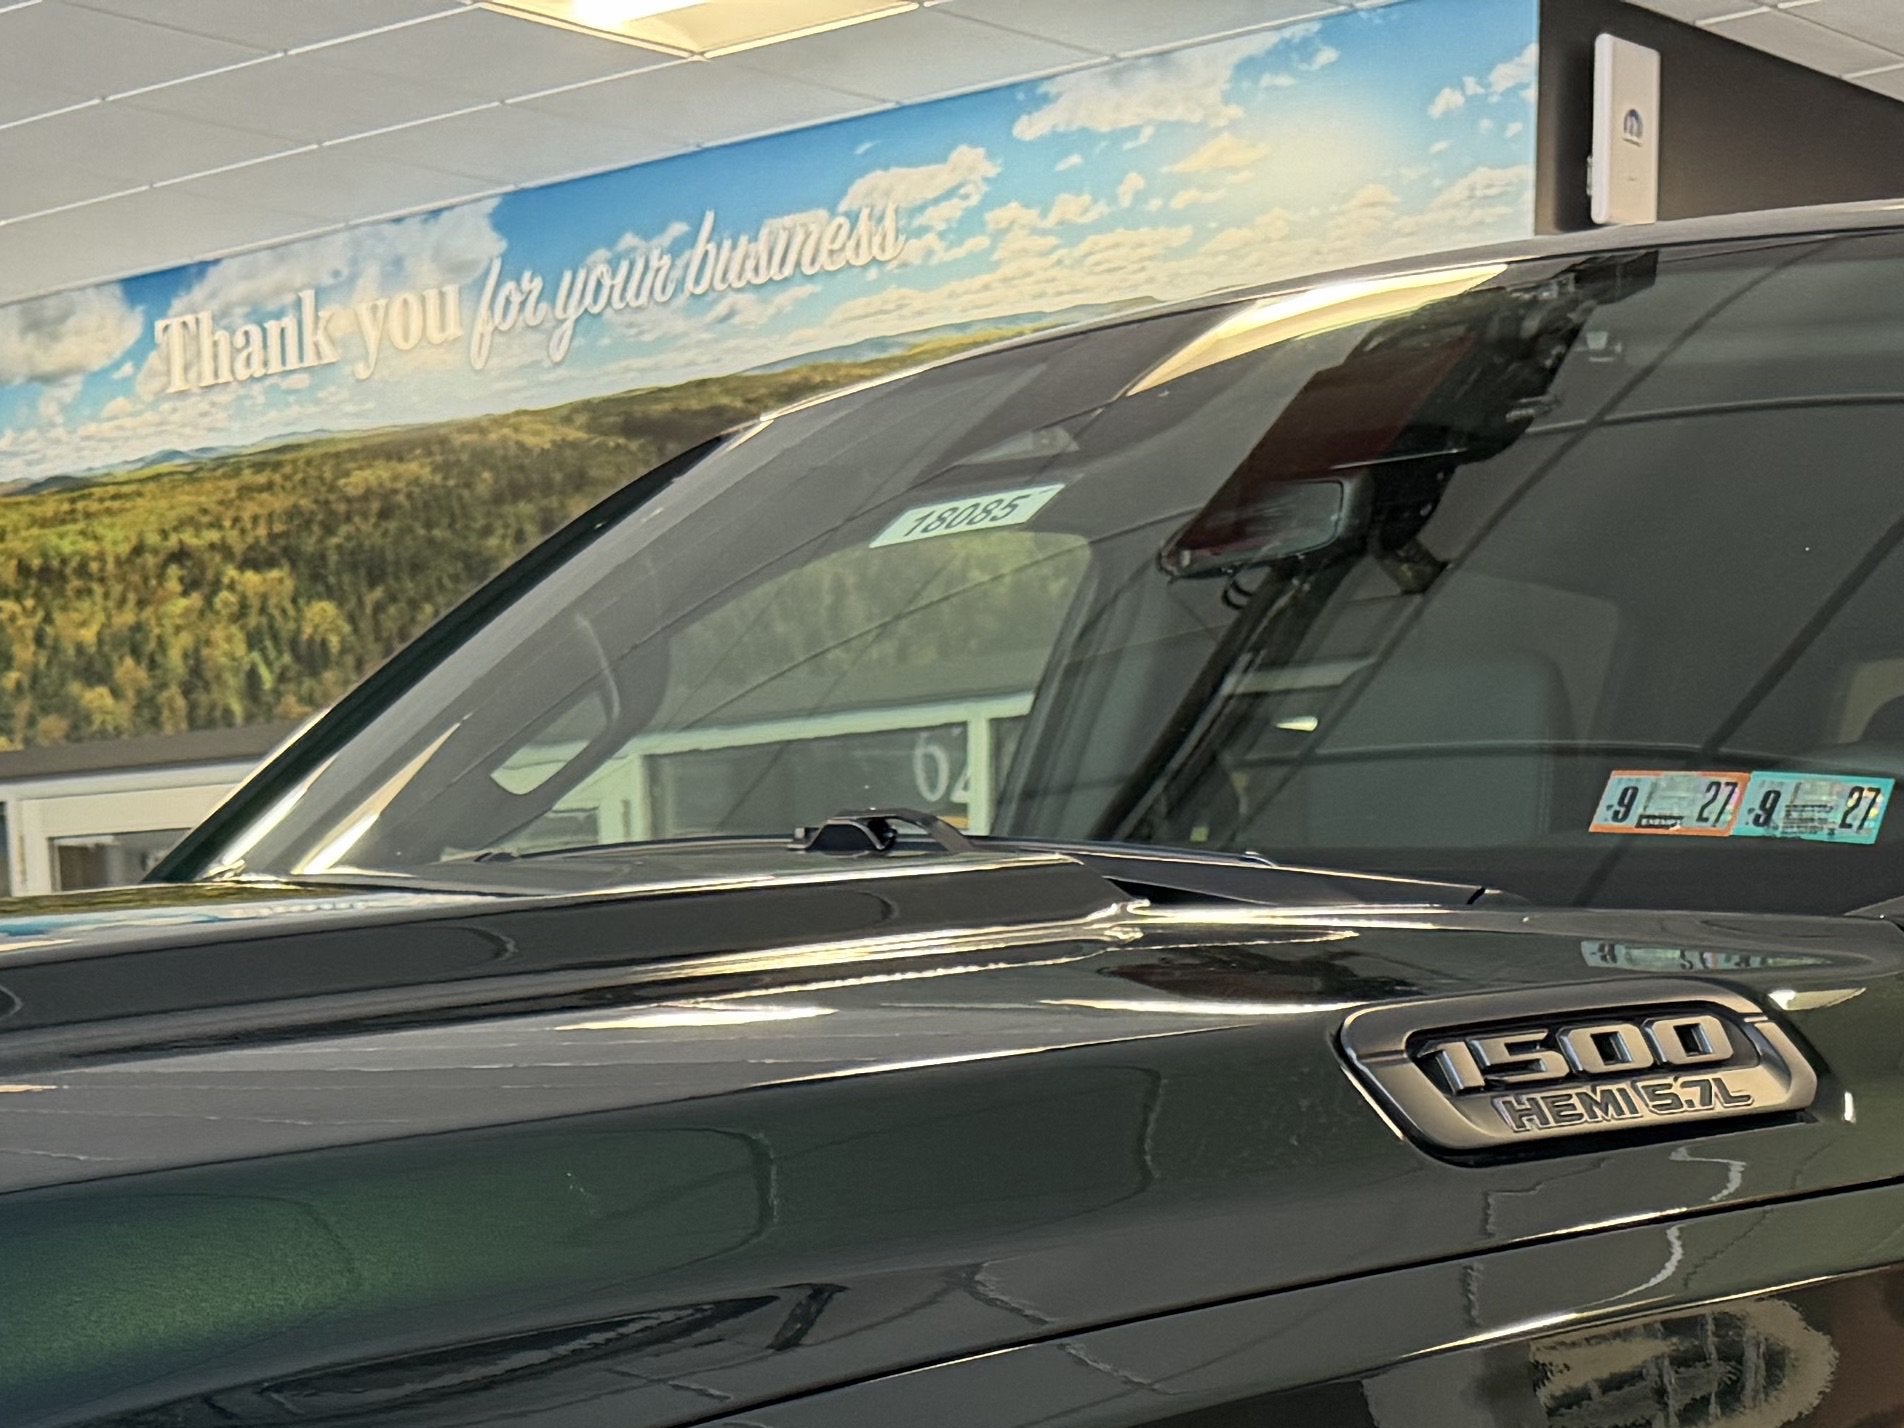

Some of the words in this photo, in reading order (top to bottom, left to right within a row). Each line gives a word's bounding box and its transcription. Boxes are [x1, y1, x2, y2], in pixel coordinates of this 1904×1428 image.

[155, 289, 341, 396] Thank
[353, 283, 466, 382] you
[468, 256, 550, 372] for
[552, 246, 676, 364] your
[684, 204, 908, 297] business
[904, 494, 1031, 538] 18085
[1611, 785, 1640, 824] 9
[1696, 781, 1739, 828] 27
[1752, 789, 1782, 828] 9
[1839, 785, 1882, 834] 27
[1417, 1013, 1736, 1095] 1500
[1497, 1085, 1643, 1133] HEMI
[1639, 1075, 1755, 1118] 5.7L
